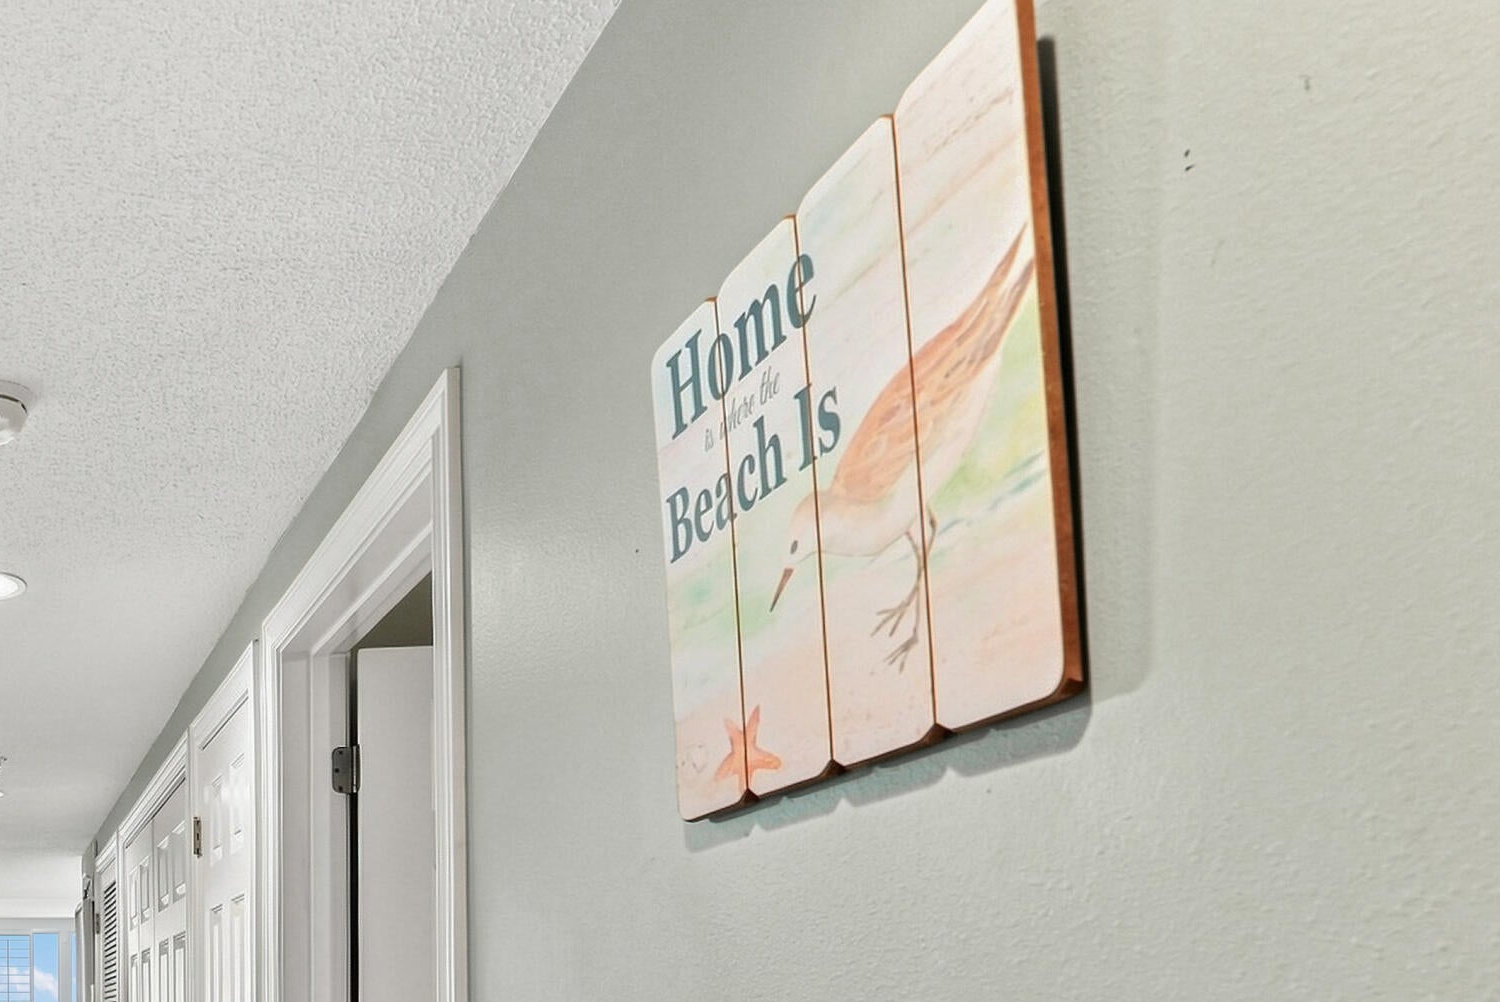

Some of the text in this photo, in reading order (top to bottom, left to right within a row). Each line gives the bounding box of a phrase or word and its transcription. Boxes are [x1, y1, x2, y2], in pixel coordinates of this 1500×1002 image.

[666, 253, 816, 440] Home
[705, 428, 714, 453] is
[760, 366, 780, 405] the
[666, 383, 841, 564] Beach Is
